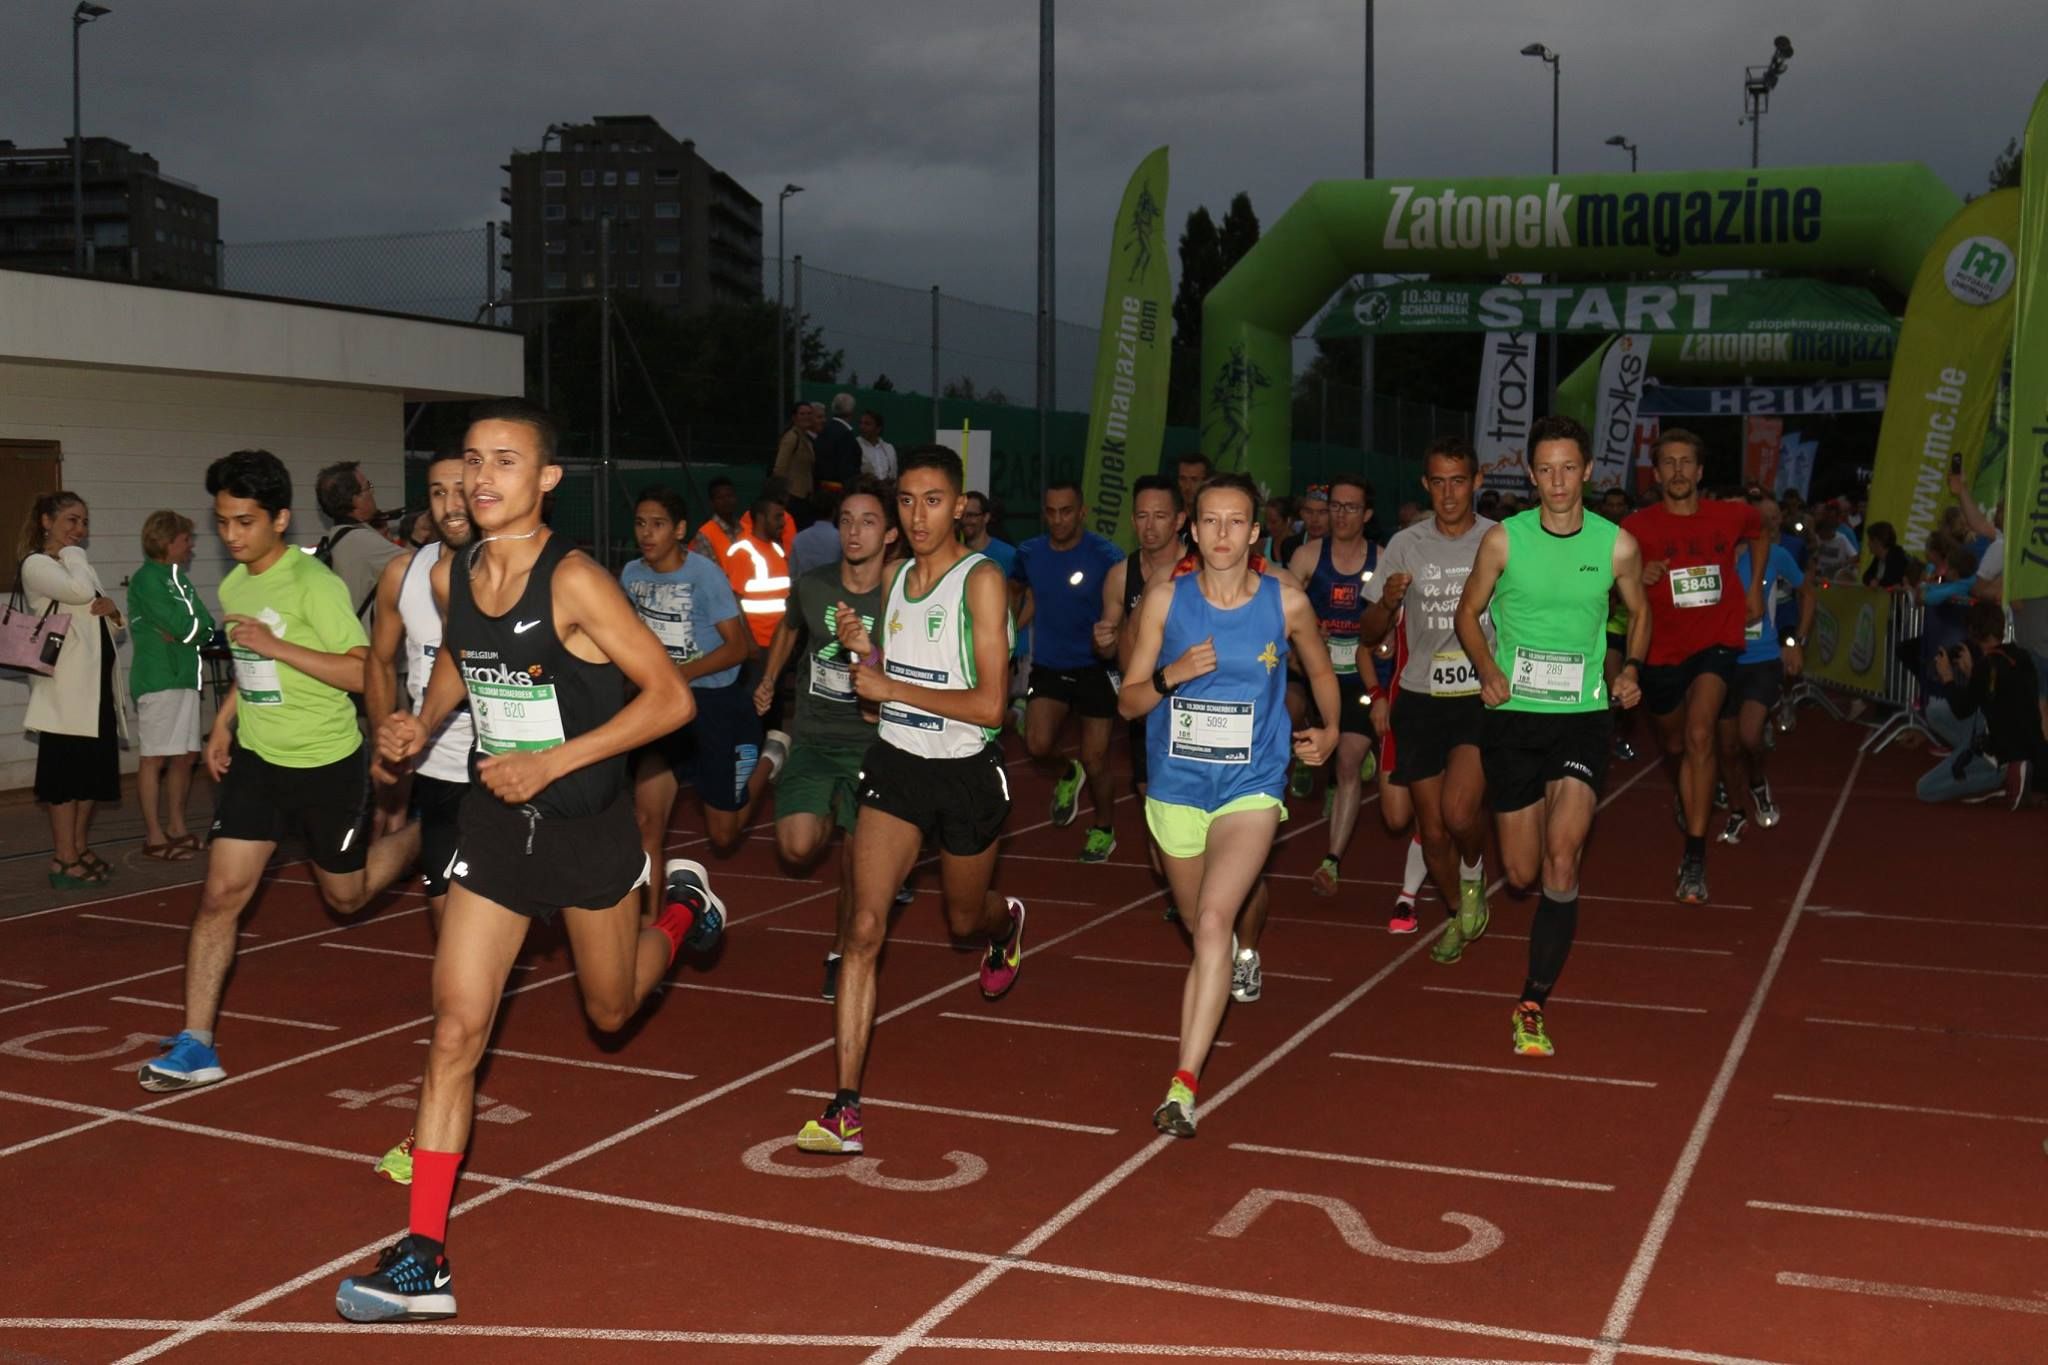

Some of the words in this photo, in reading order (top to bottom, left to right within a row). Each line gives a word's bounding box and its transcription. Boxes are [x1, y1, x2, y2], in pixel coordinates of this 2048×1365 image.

[1478, 284, 1728, 330] START
[1903, 366, 1968, 552] www.mc.be
[1680, 576, 1716, 592] 3848
[466, 650, 499, 660] BELGIUM
[1433, 665, 1479, 684] 4504
[1546, 664, 1563, 675] 289
[504, 701, 526, 719] 620
[1207, 716, 1228, 728] 5092
[741, 1134, 988, 1192] 3
[1207, 1188, 1505, 1264] 2
